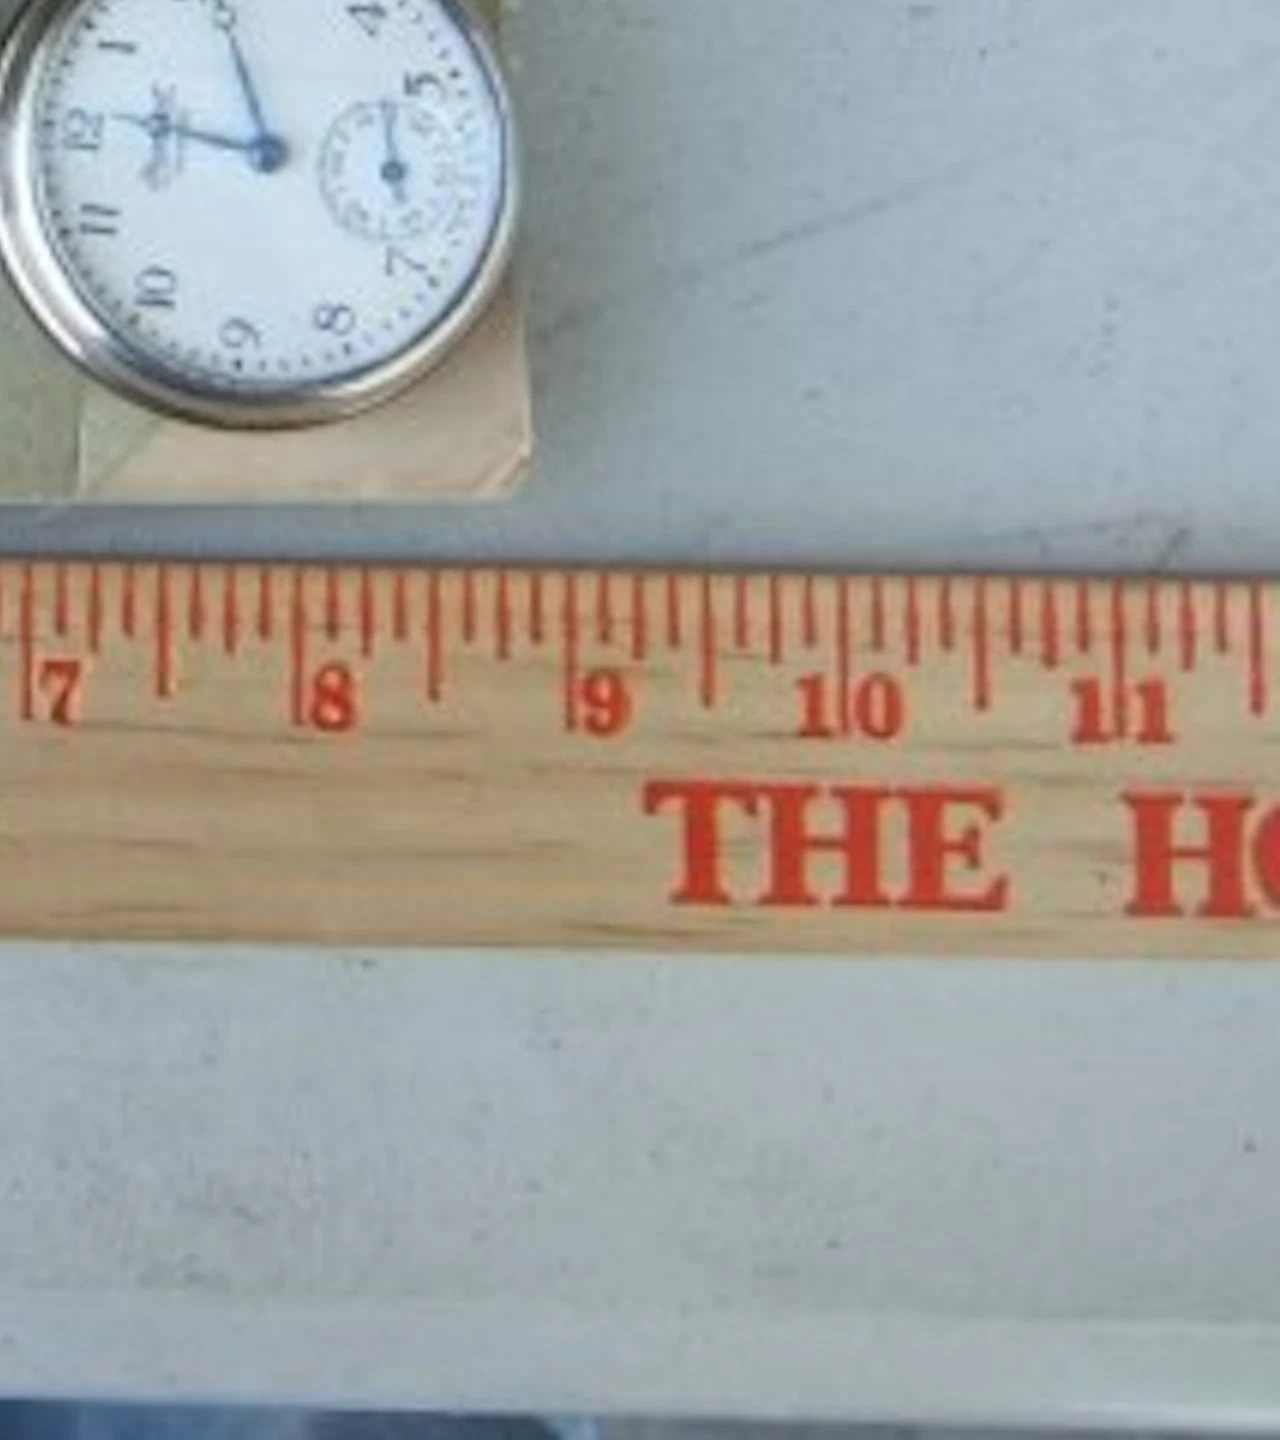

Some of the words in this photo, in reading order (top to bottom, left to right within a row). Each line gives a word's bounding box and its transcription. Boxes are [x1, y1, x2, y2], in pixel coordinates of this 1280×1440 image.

[346, 0, 388, 37] 4
[98, 39, 136, 54] 1
[404, 70, 441, 97] 5
[67, 107, 104, 151] 12
[78, 203, 120, 236] 11
[135, 265, 177, 310] 10
[220, 317, 262, 351] 9
[313, 304, 356, 337] 8
[38, 659, 83, 726] 7
[307, 664, 358, 732] 8
[580, 668, 631, 737] 9
[794, 673, 906, 739] 10
[1069, 679, 1175, 744] 11
[644, 779, 1009, 913] THE
[1121, 791, 1280, 920] H
